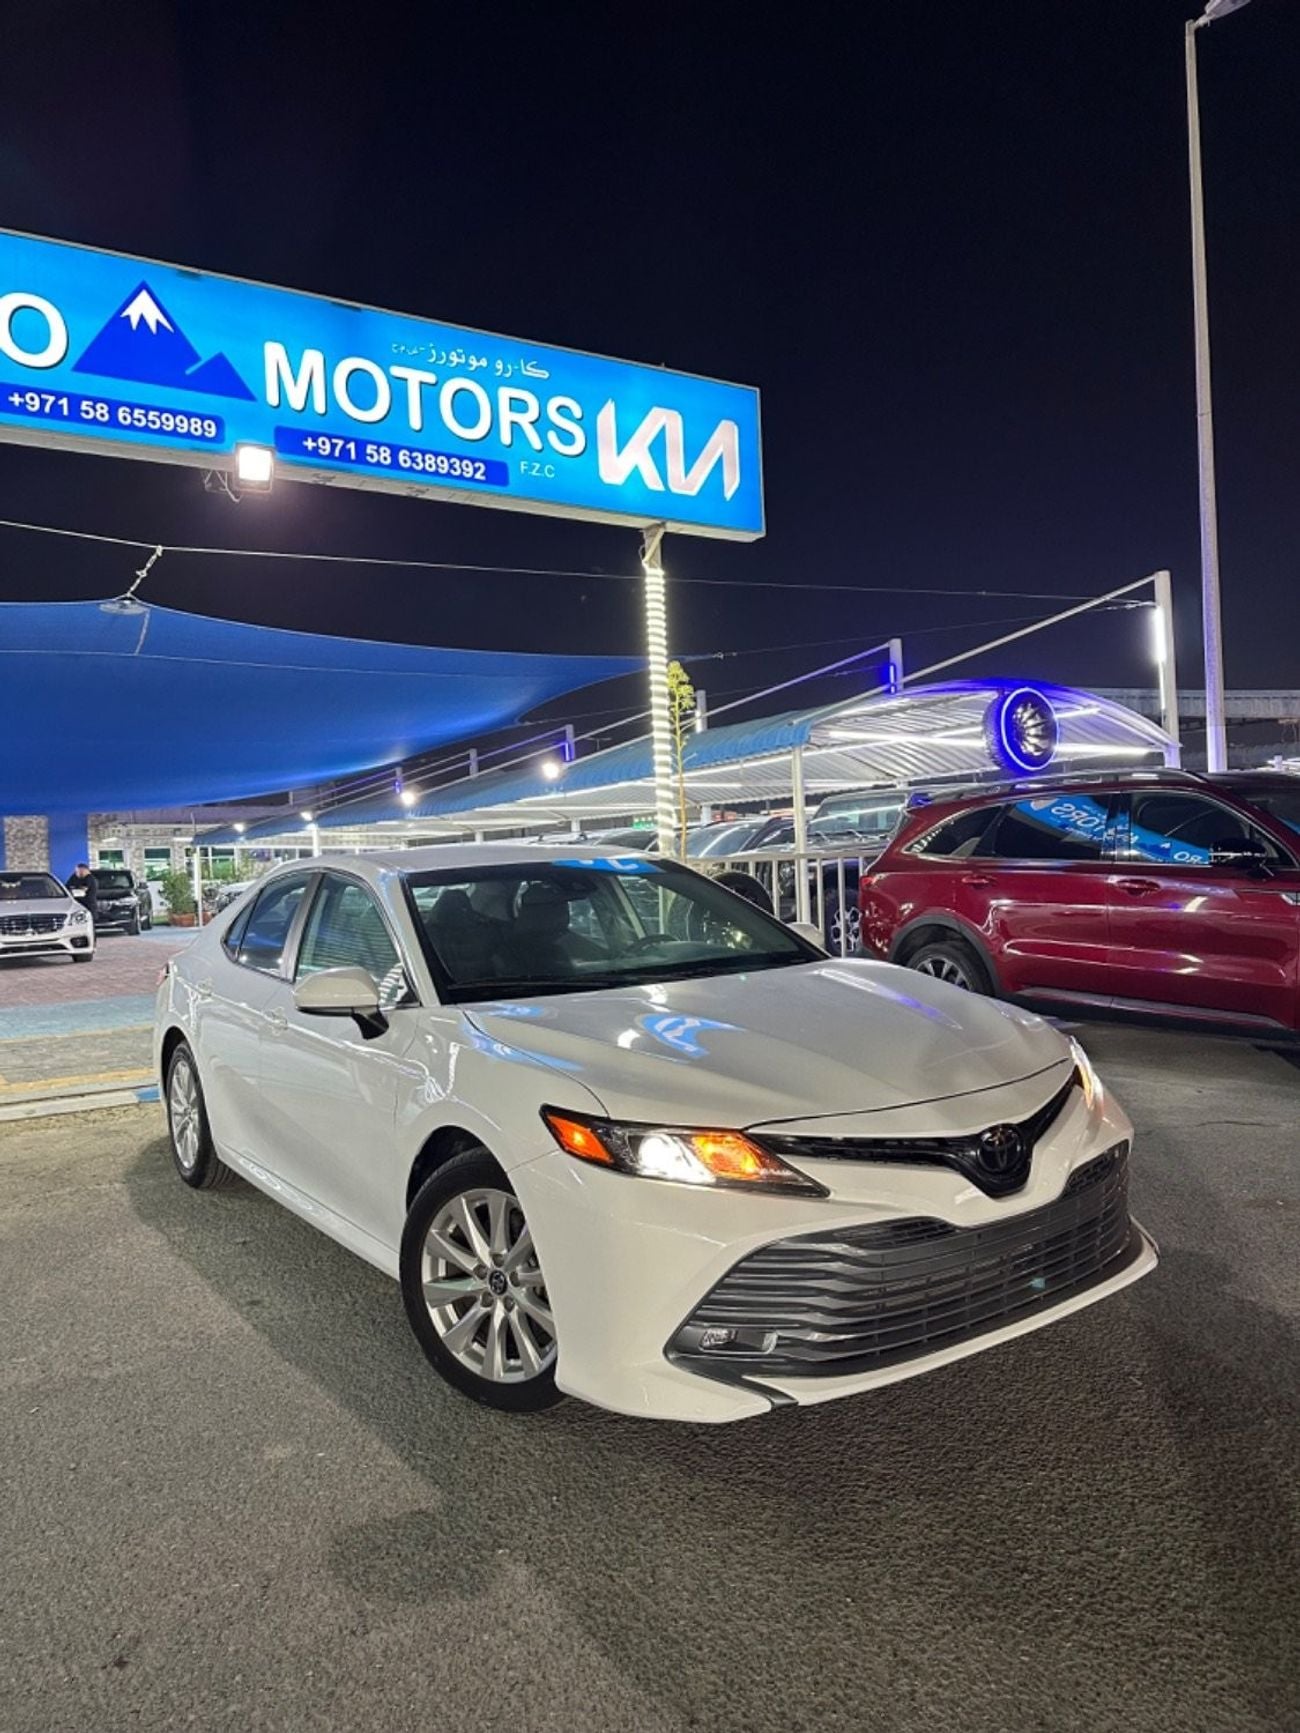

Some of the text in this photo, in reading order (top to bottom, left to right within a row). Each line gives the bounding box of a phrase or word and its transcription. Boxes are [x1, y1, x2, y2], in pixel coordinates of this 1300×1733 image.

[428, 343, 488, 370] موتورز
[8, 392, 216, 438] +971 58 6559989
[264, 341, 587, 457] MOTORS
[303, 436, 486, 481] +971 58 6389392
